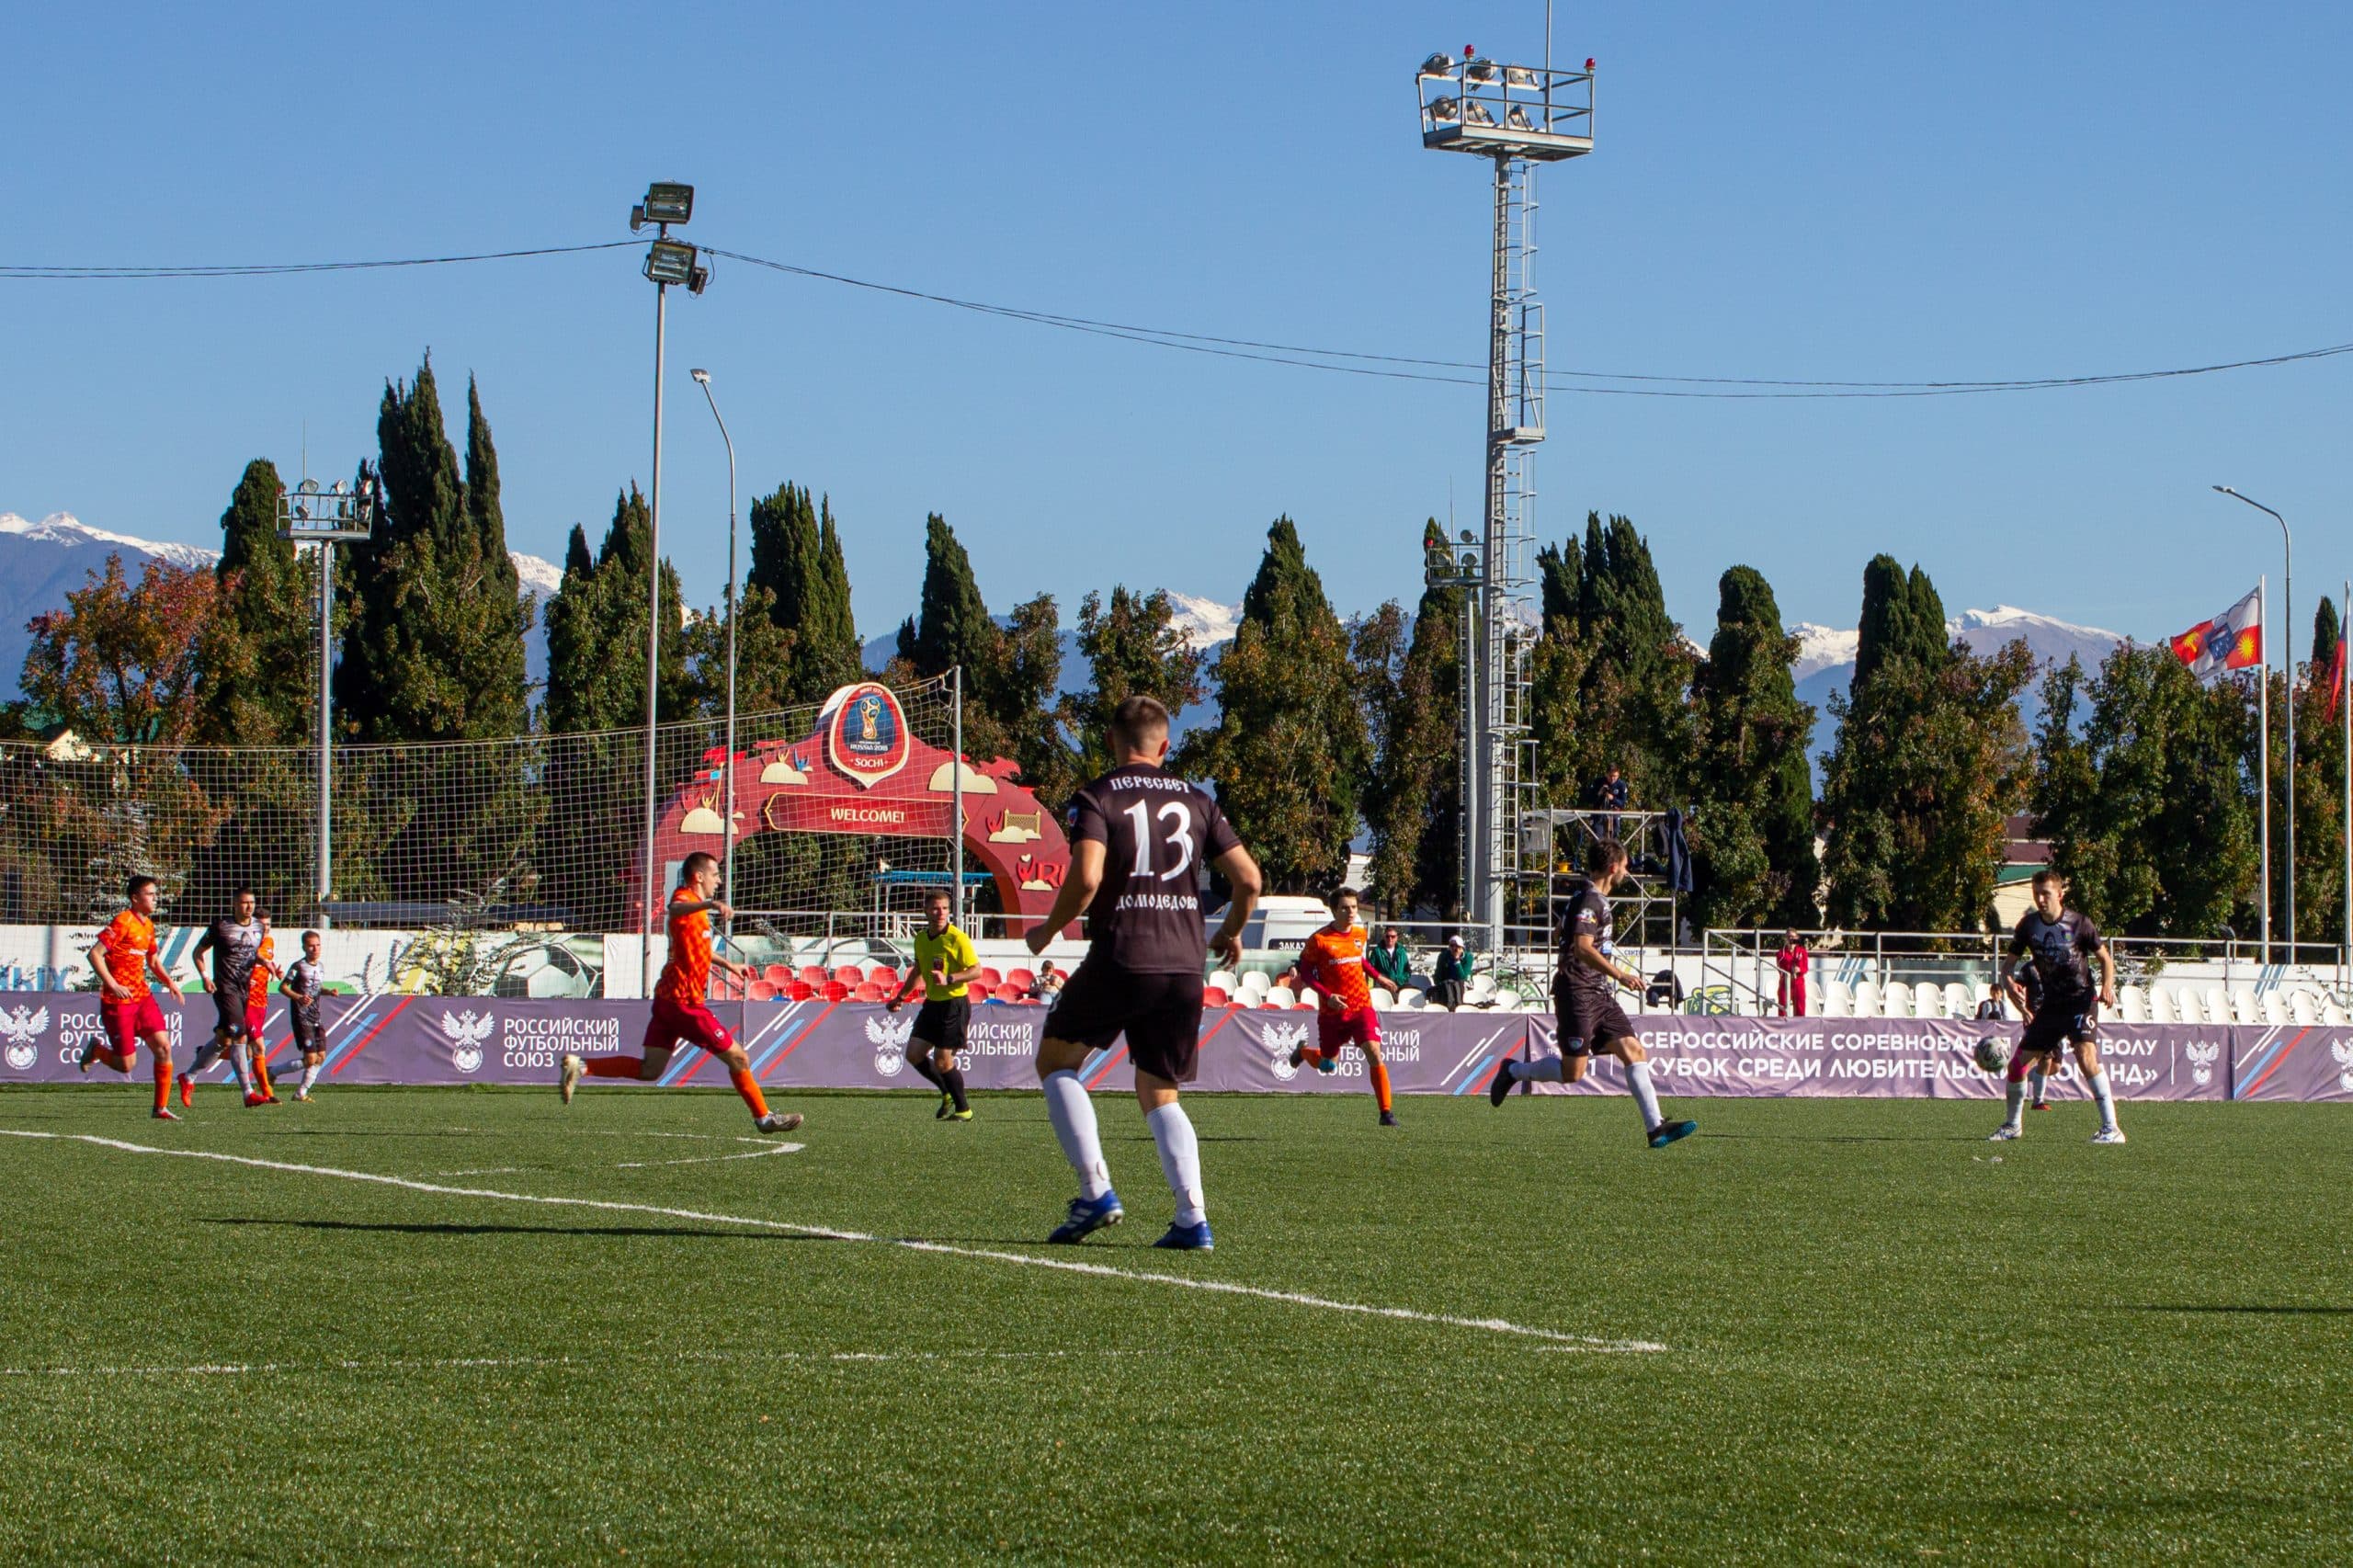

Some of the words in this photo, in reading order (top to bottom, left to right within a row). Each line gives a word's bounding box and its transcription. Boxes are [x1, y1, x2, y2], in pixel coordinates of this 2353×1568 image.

[855, 757, 884, 768] SOCHI
[1109, 776, 1191, 794] ПЕРЕСВЕТ
[831, 808, 904, 824] WELCOME!
[1123, 798, 1194, 881] 13
[1115, 894, 1199, 912] ДОМОДЕДОВО
[504, 1017, 620, 1036] РОССИЙСКИЙ
[2074, 1014, 2096, 1029] 76
[504, 1033, 620, 1051] ФУТБОЛЬНЫЙ
[1635, 1029, 1824, 1051] СЕРОССИЙСКИЕ
[504, 1051, 554, 1068] СОЮЗ
[1738, 1057, 1822, 1081] СРЕДИ
